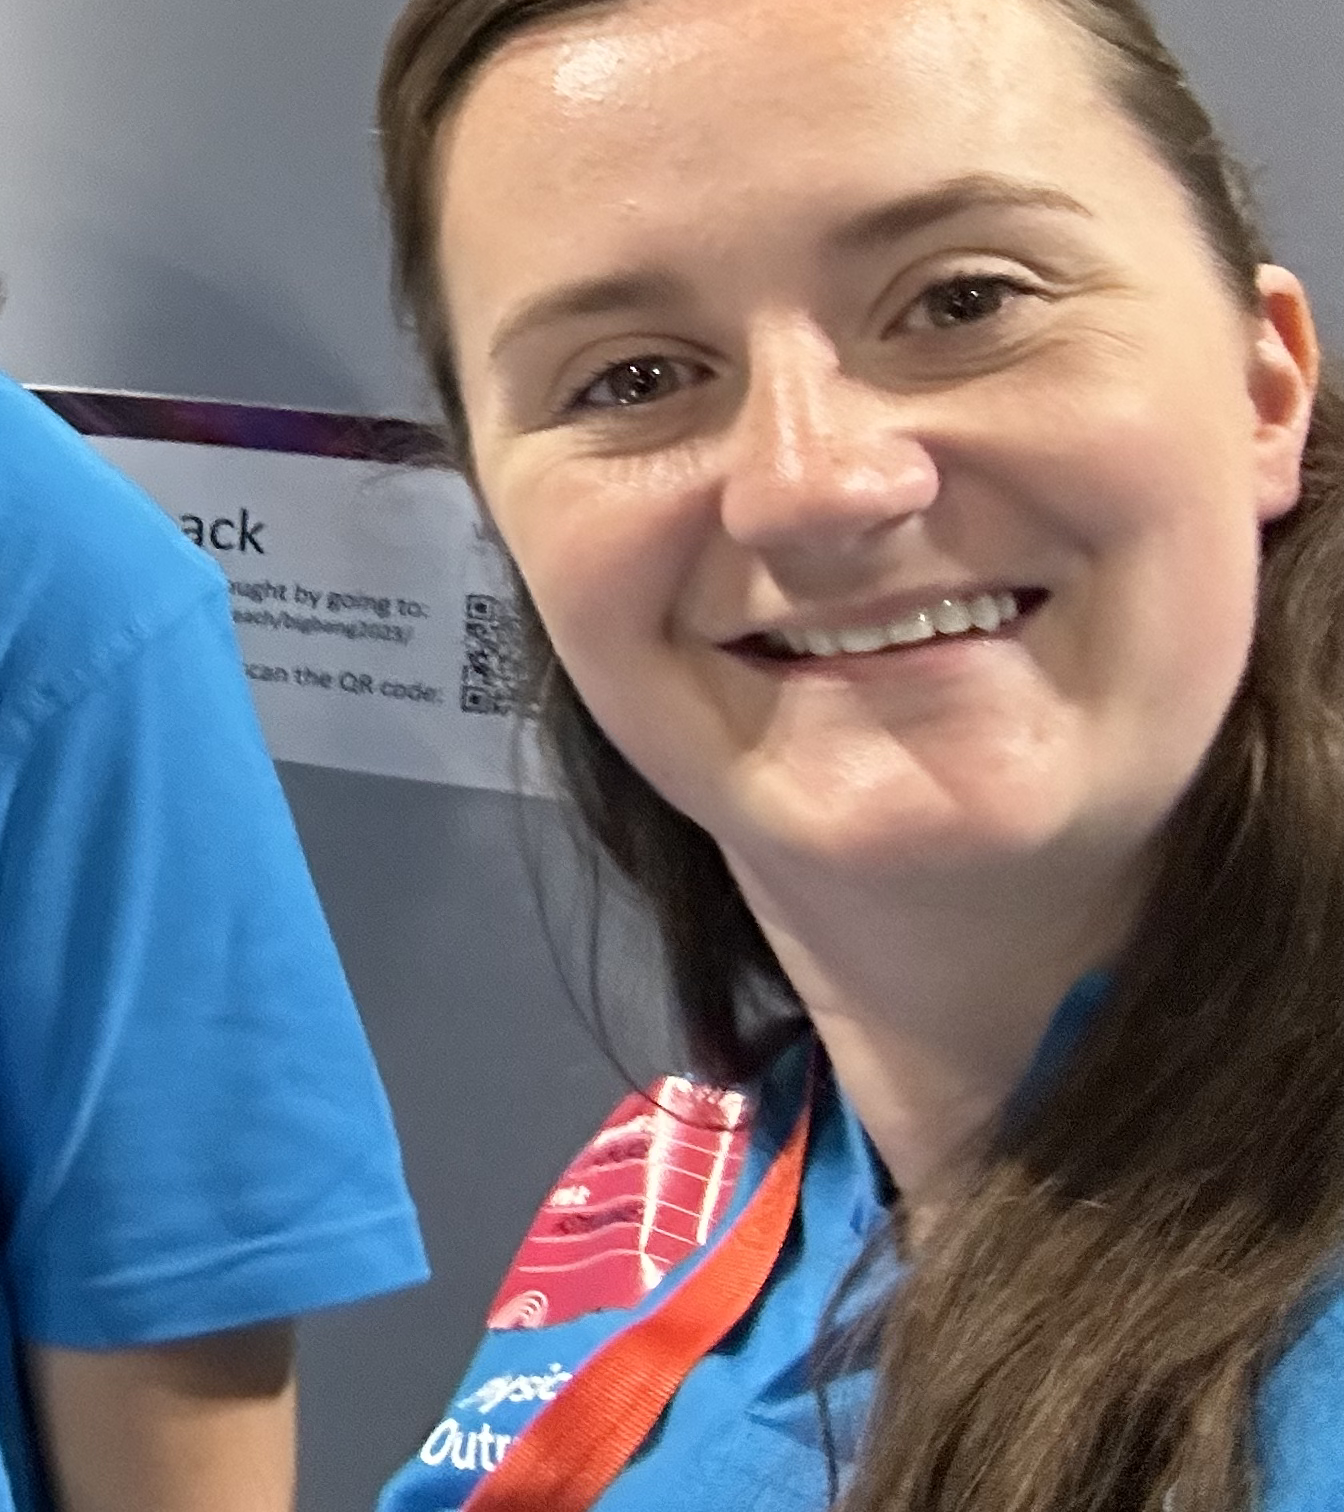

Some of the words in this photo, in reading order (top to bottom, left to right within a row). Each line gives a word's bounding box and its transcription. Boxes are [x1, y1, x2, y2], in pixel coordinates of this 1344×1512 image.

[294, 584, 321, 609] by
[326, 591, 391, 619] going
[292, 666, 332, 689] the
[339, 671, 374, 695] QR
[420, 1418, 520, 1472] Outr
